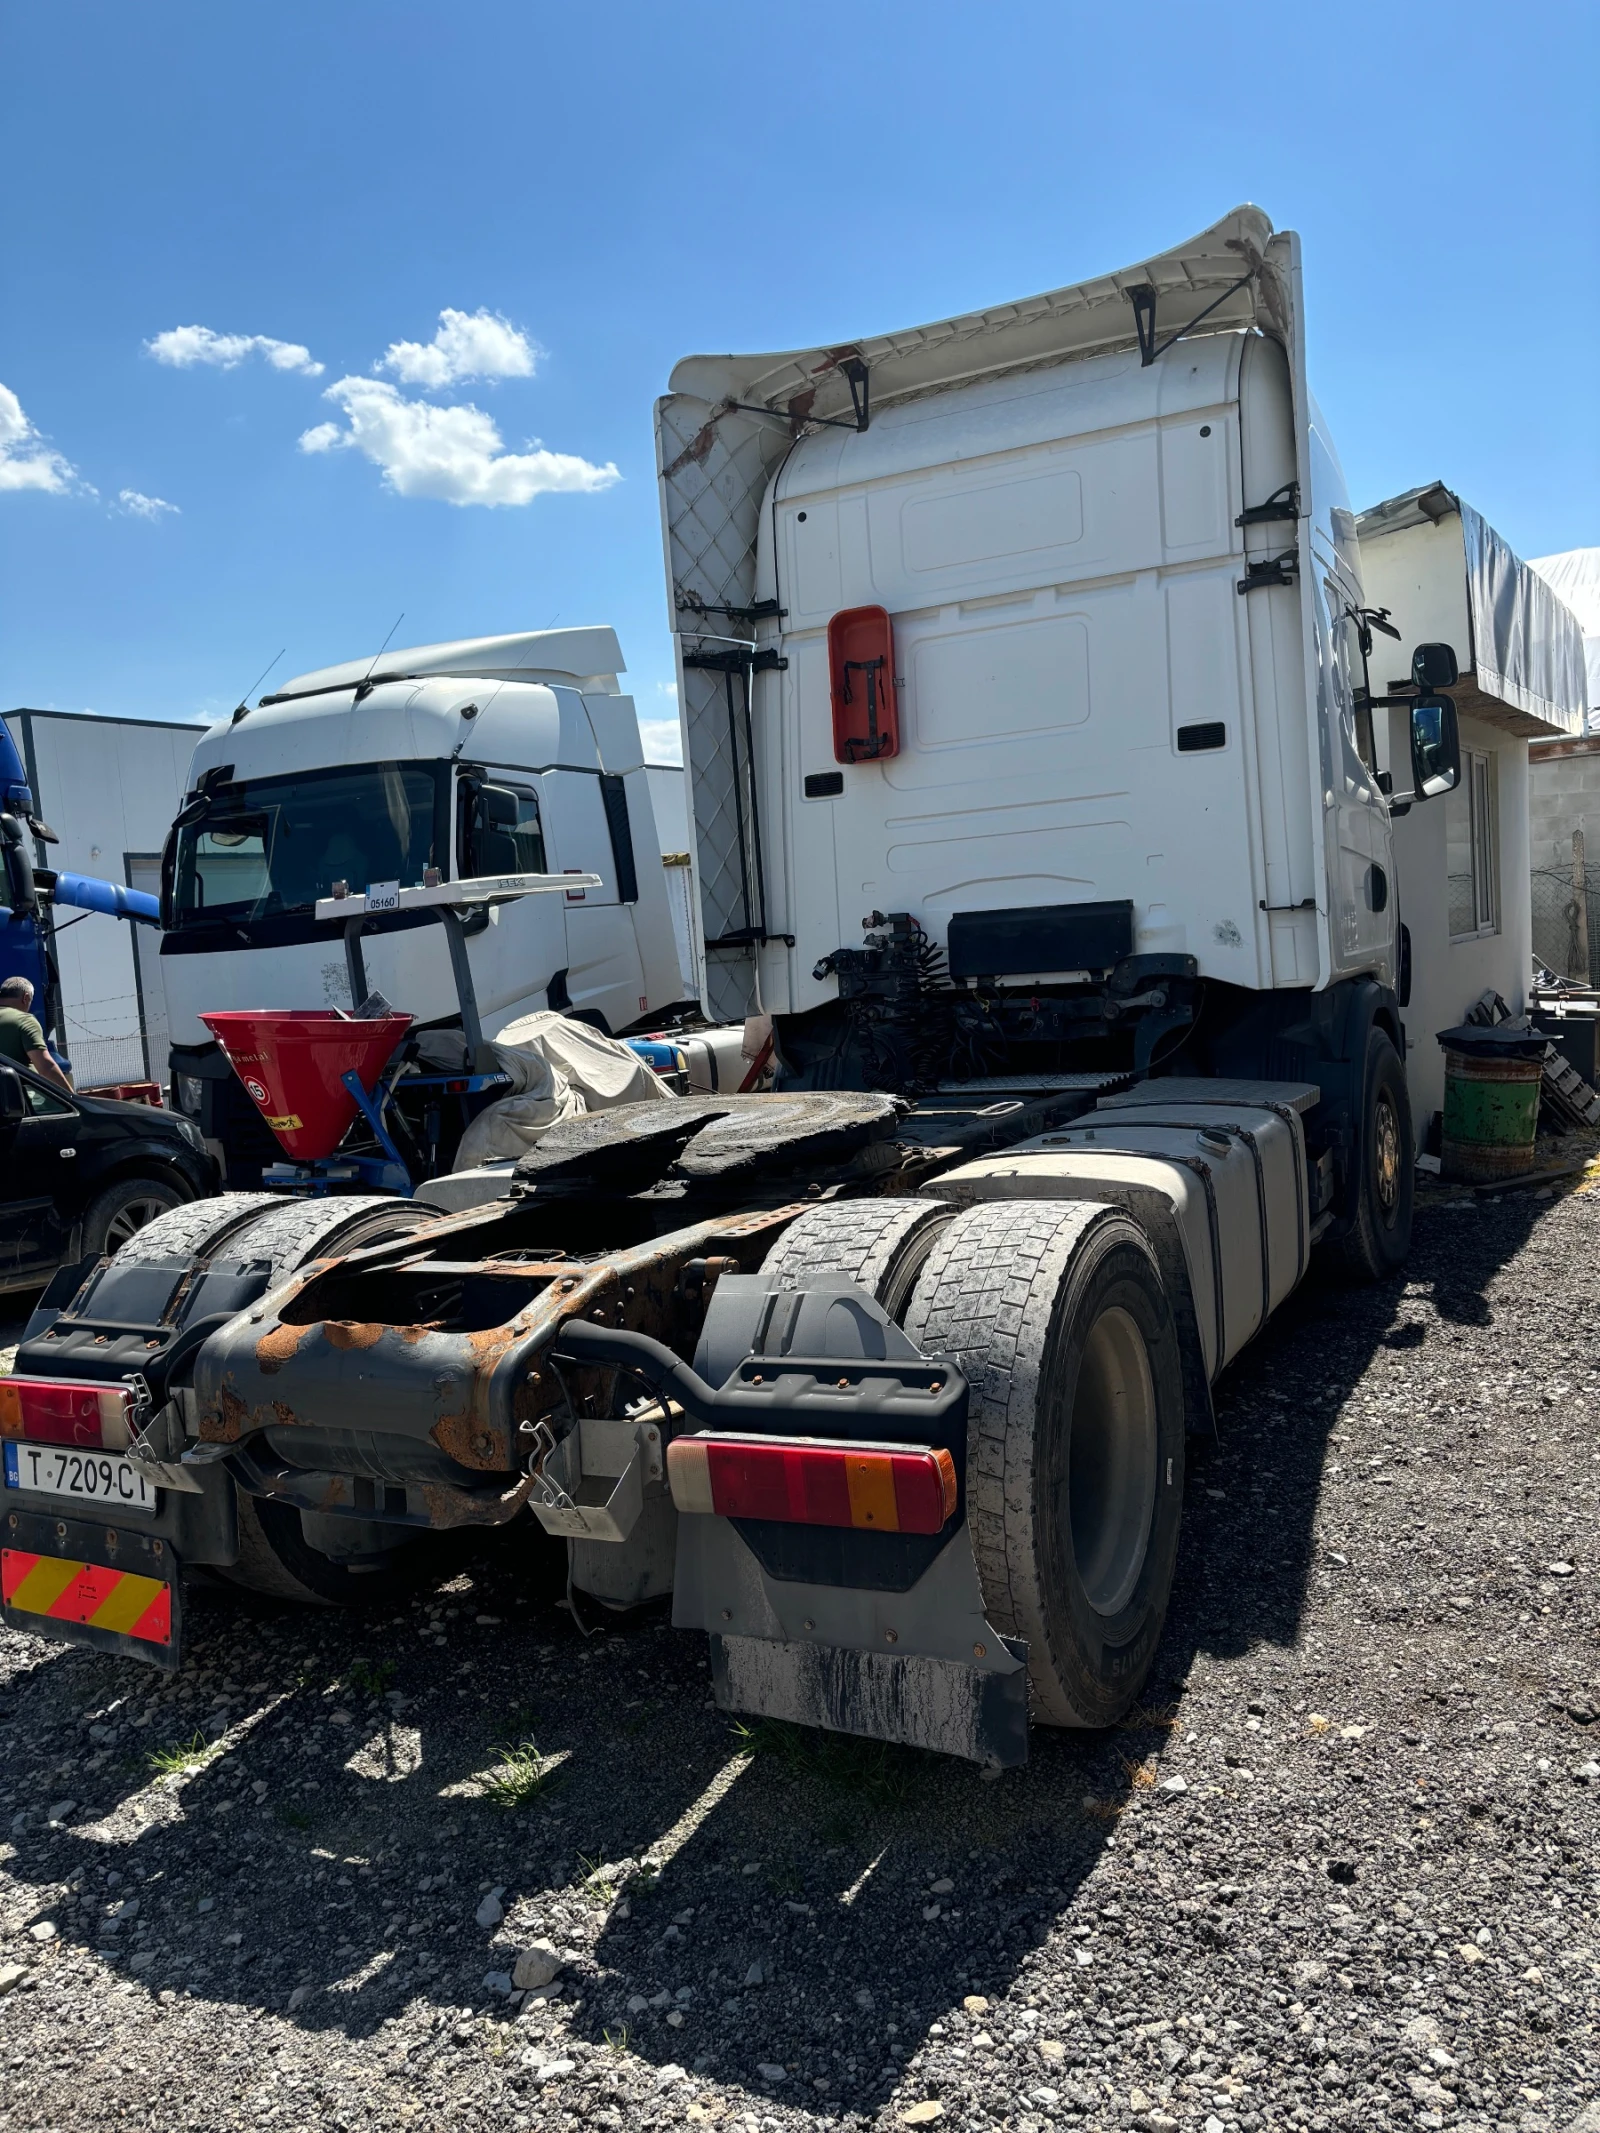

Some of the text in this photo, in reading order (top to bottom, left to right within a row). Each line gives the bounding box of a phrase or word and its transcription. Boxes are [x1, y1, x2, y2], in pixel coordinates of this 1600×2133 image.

[370, 897, 395, 909] 05160
[249, 1084, 265, 1098] 15
[8, 1470, 19, 1482] BG
